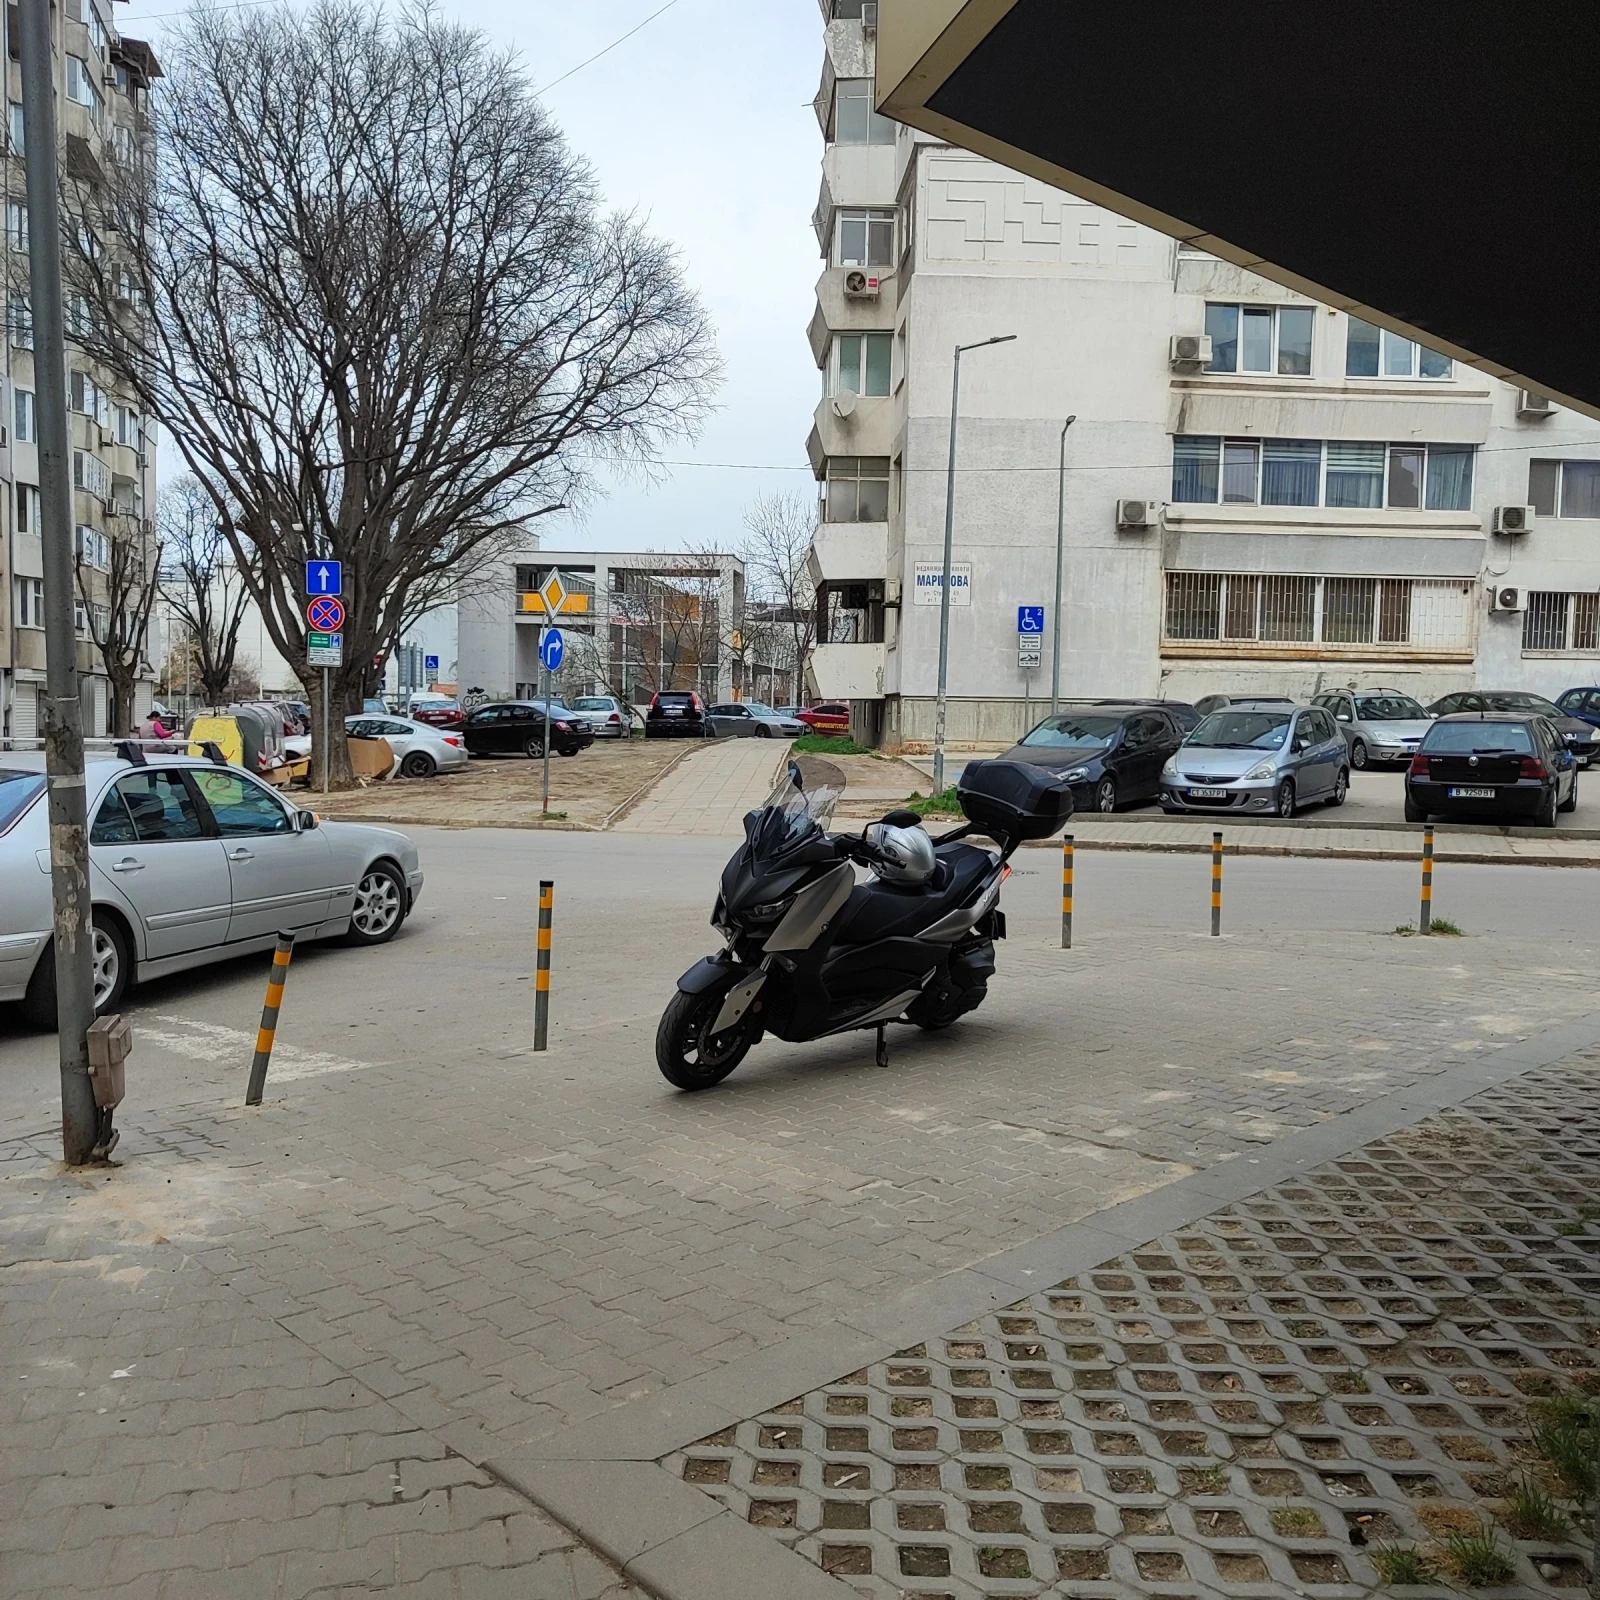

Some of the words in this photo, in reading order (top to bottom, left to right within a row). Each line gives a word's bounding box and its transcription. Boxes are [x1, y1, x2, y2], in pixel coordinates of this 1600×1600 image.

[916, 574, 969, 587] МАРИОВА
[1036, 608, 1043, 616] 2
[1201, 788, 1215, 797] 3537
[1455, 788, 1461, 796] B
[1464, 788, 1482, 797] 9250
